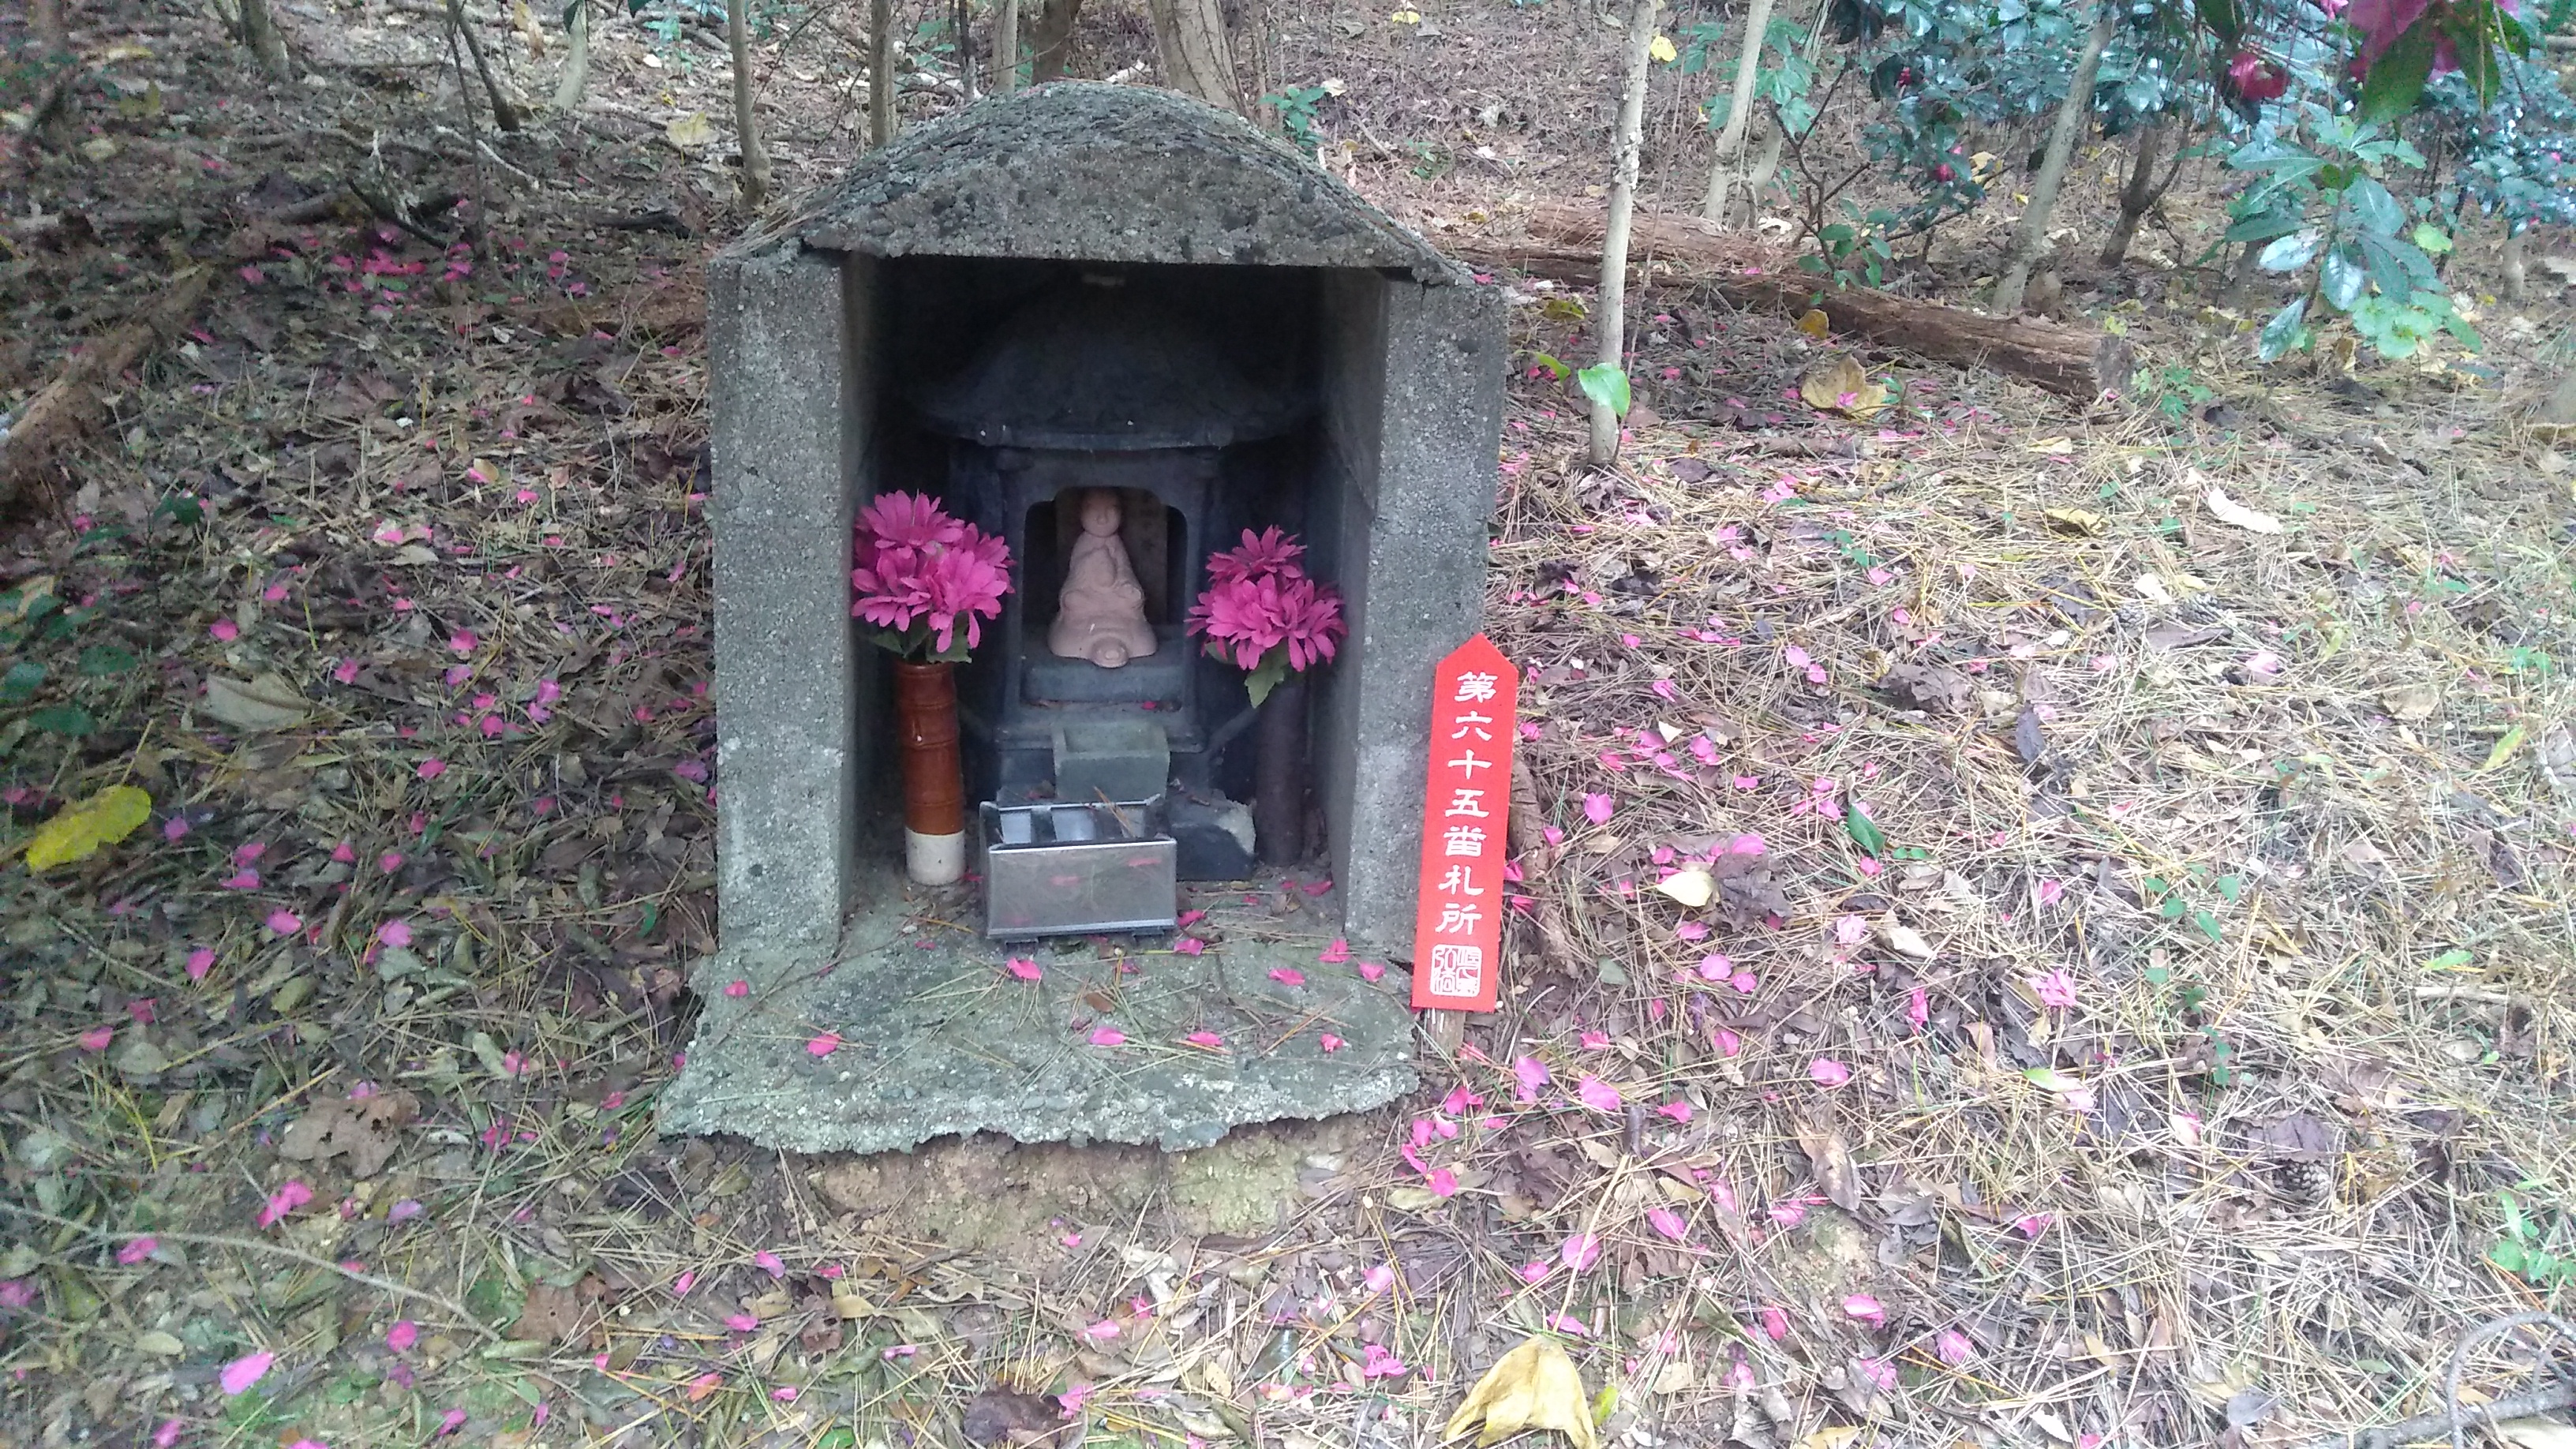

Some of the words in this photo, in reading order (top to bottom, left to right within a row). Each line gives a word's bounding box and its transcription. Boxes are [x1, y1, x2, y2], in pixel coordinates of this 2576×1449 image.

[1435, 671, 1498, 936] 第六十五番札所
